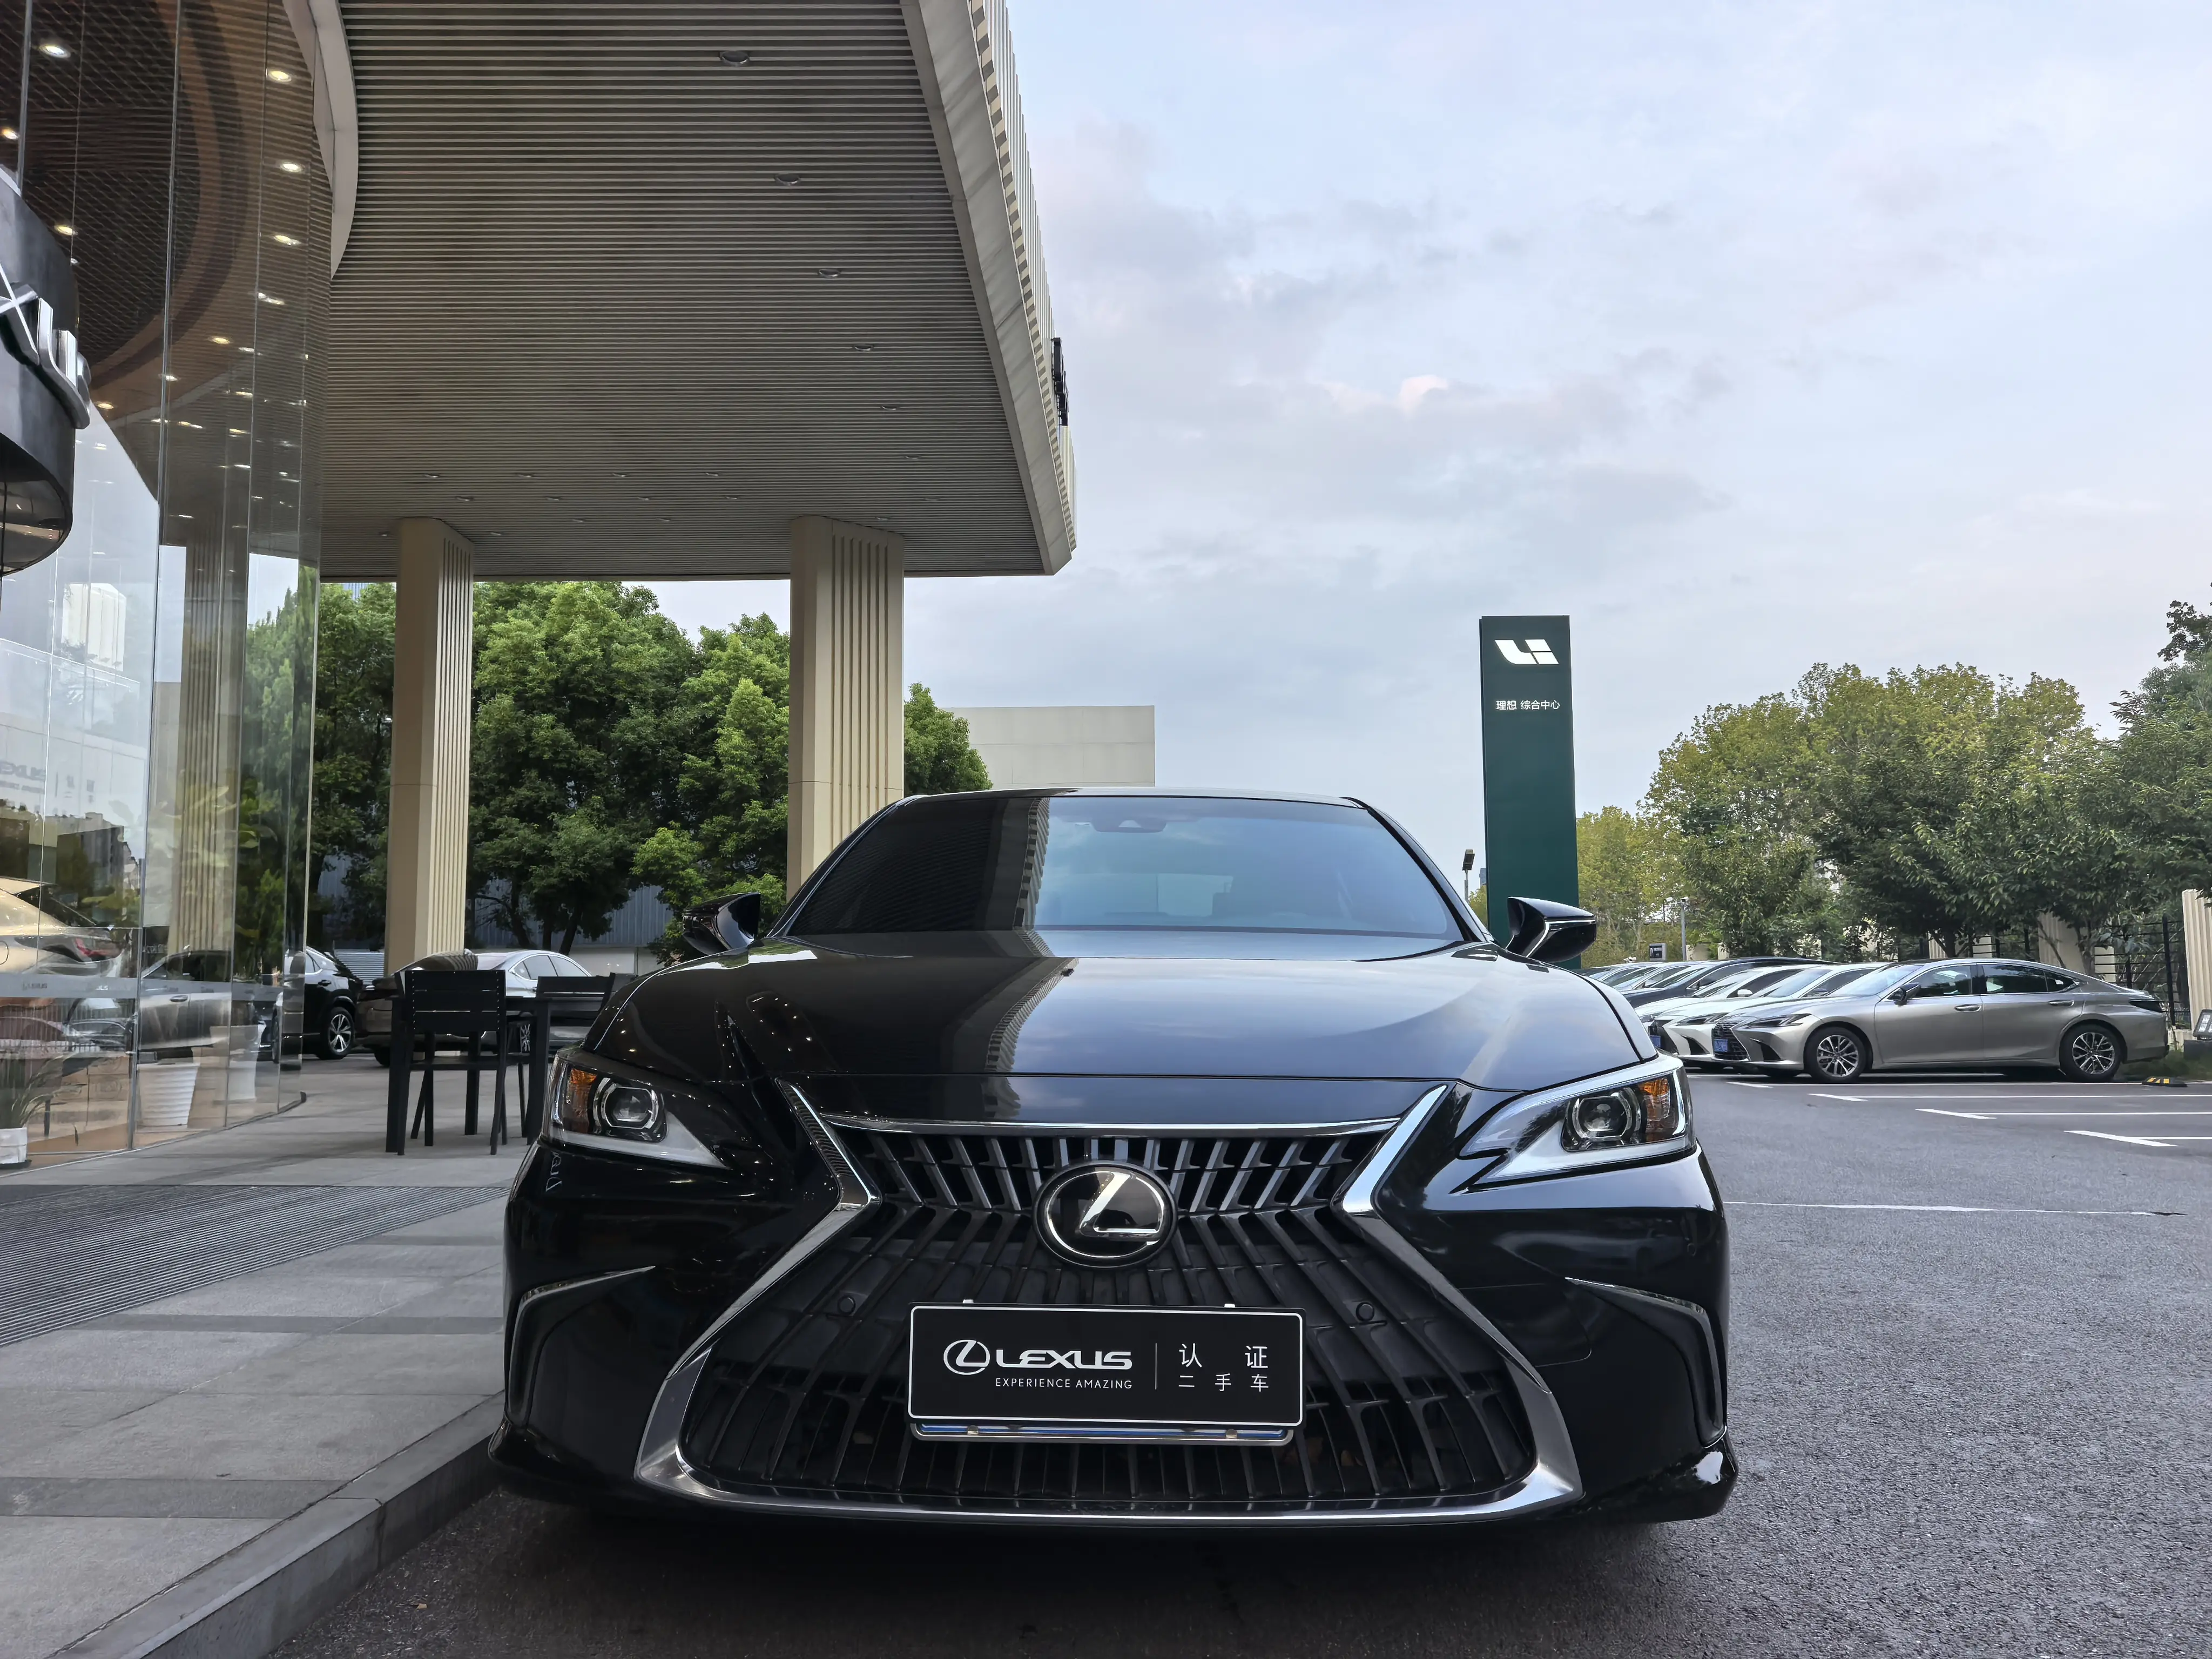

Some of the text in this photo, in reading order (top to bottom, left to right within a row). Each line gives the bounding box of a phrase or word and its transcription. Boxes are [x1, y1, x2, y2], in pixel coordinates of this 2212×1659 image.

[1495, 699, 1561, 710] 理想 综合中心
[996, 1349, 1132, 1370] LEXUS
[1178, 1343, 1269, 1368] 认证
[995, 1377, 1132, 1390] EXPERIENCE AMAZING
[1178, 1373, 1269, 1392] 二手车
